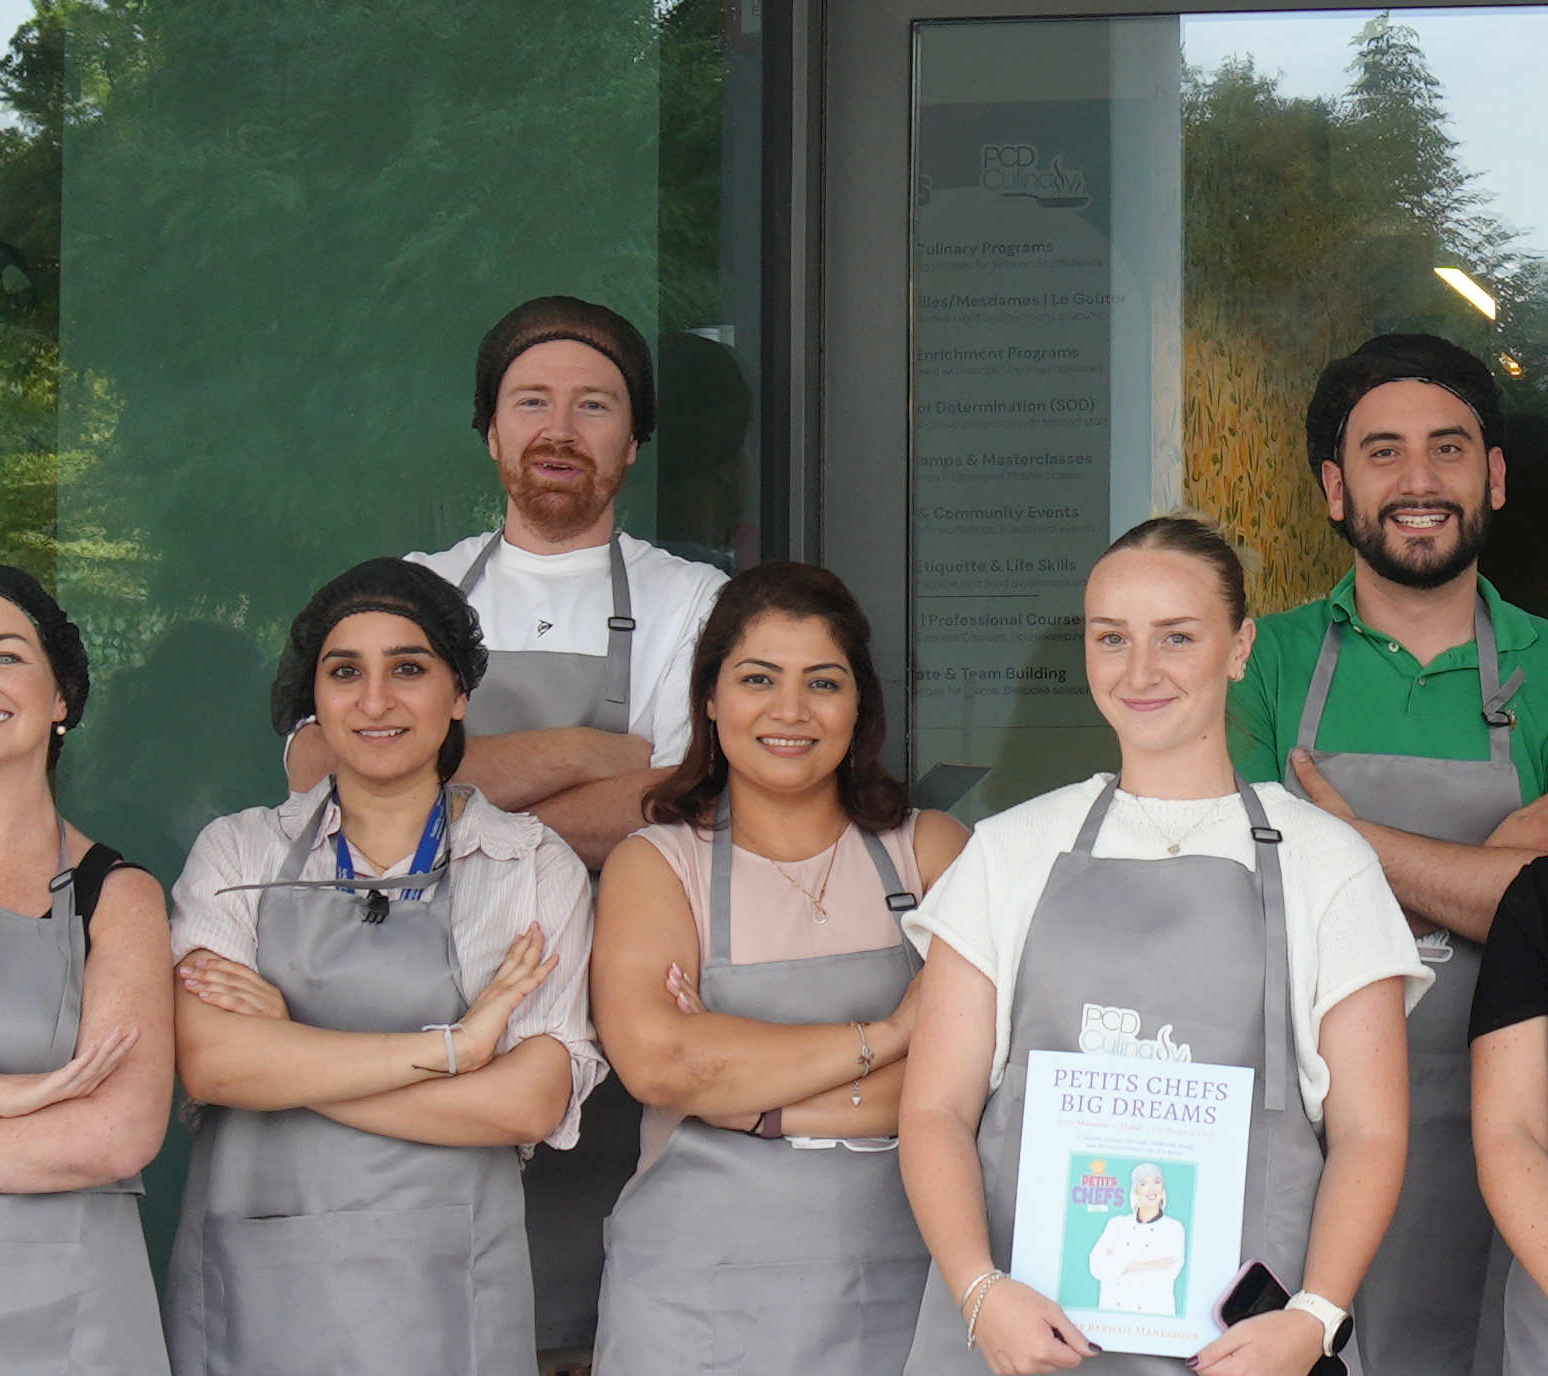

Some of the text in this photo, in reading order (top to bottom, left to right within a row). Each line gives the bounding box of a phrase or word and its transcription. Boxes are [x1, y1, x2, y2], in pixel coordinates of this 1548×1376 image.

[984, 145, 1036, 167] PCD
[981, 241, 1055, 258] Programs
[1051, 292, 1070, 306] Le
[1007, 346, 1081, 364] Programs
[936, 398, 1047, 414] Determination
[916, 454, 963, 469] amps
[982, 452, 1093, 467] Masterclasses
[933, 505, 1024, 523] Community
[1027, 505, 1080, 519] Events
[1006, 559, 1034, 573] Life
[1037, 558, 1077, 572] Skills
[928, 612, 1023, 628] Professional
[1025, 612, 1085, 627] Course
[960, 666, 1002, 681] Team
[1005, 665, 1068, 684] Building
[1085, 1007, 1138, 1035] PCD
[1053, 1068, 1229, 1101] PETITS CHEFS
[1060, 1093, 1218, 1125] BIG DREAMS
[1072, 1186, 1125, 1208] CHEFS
